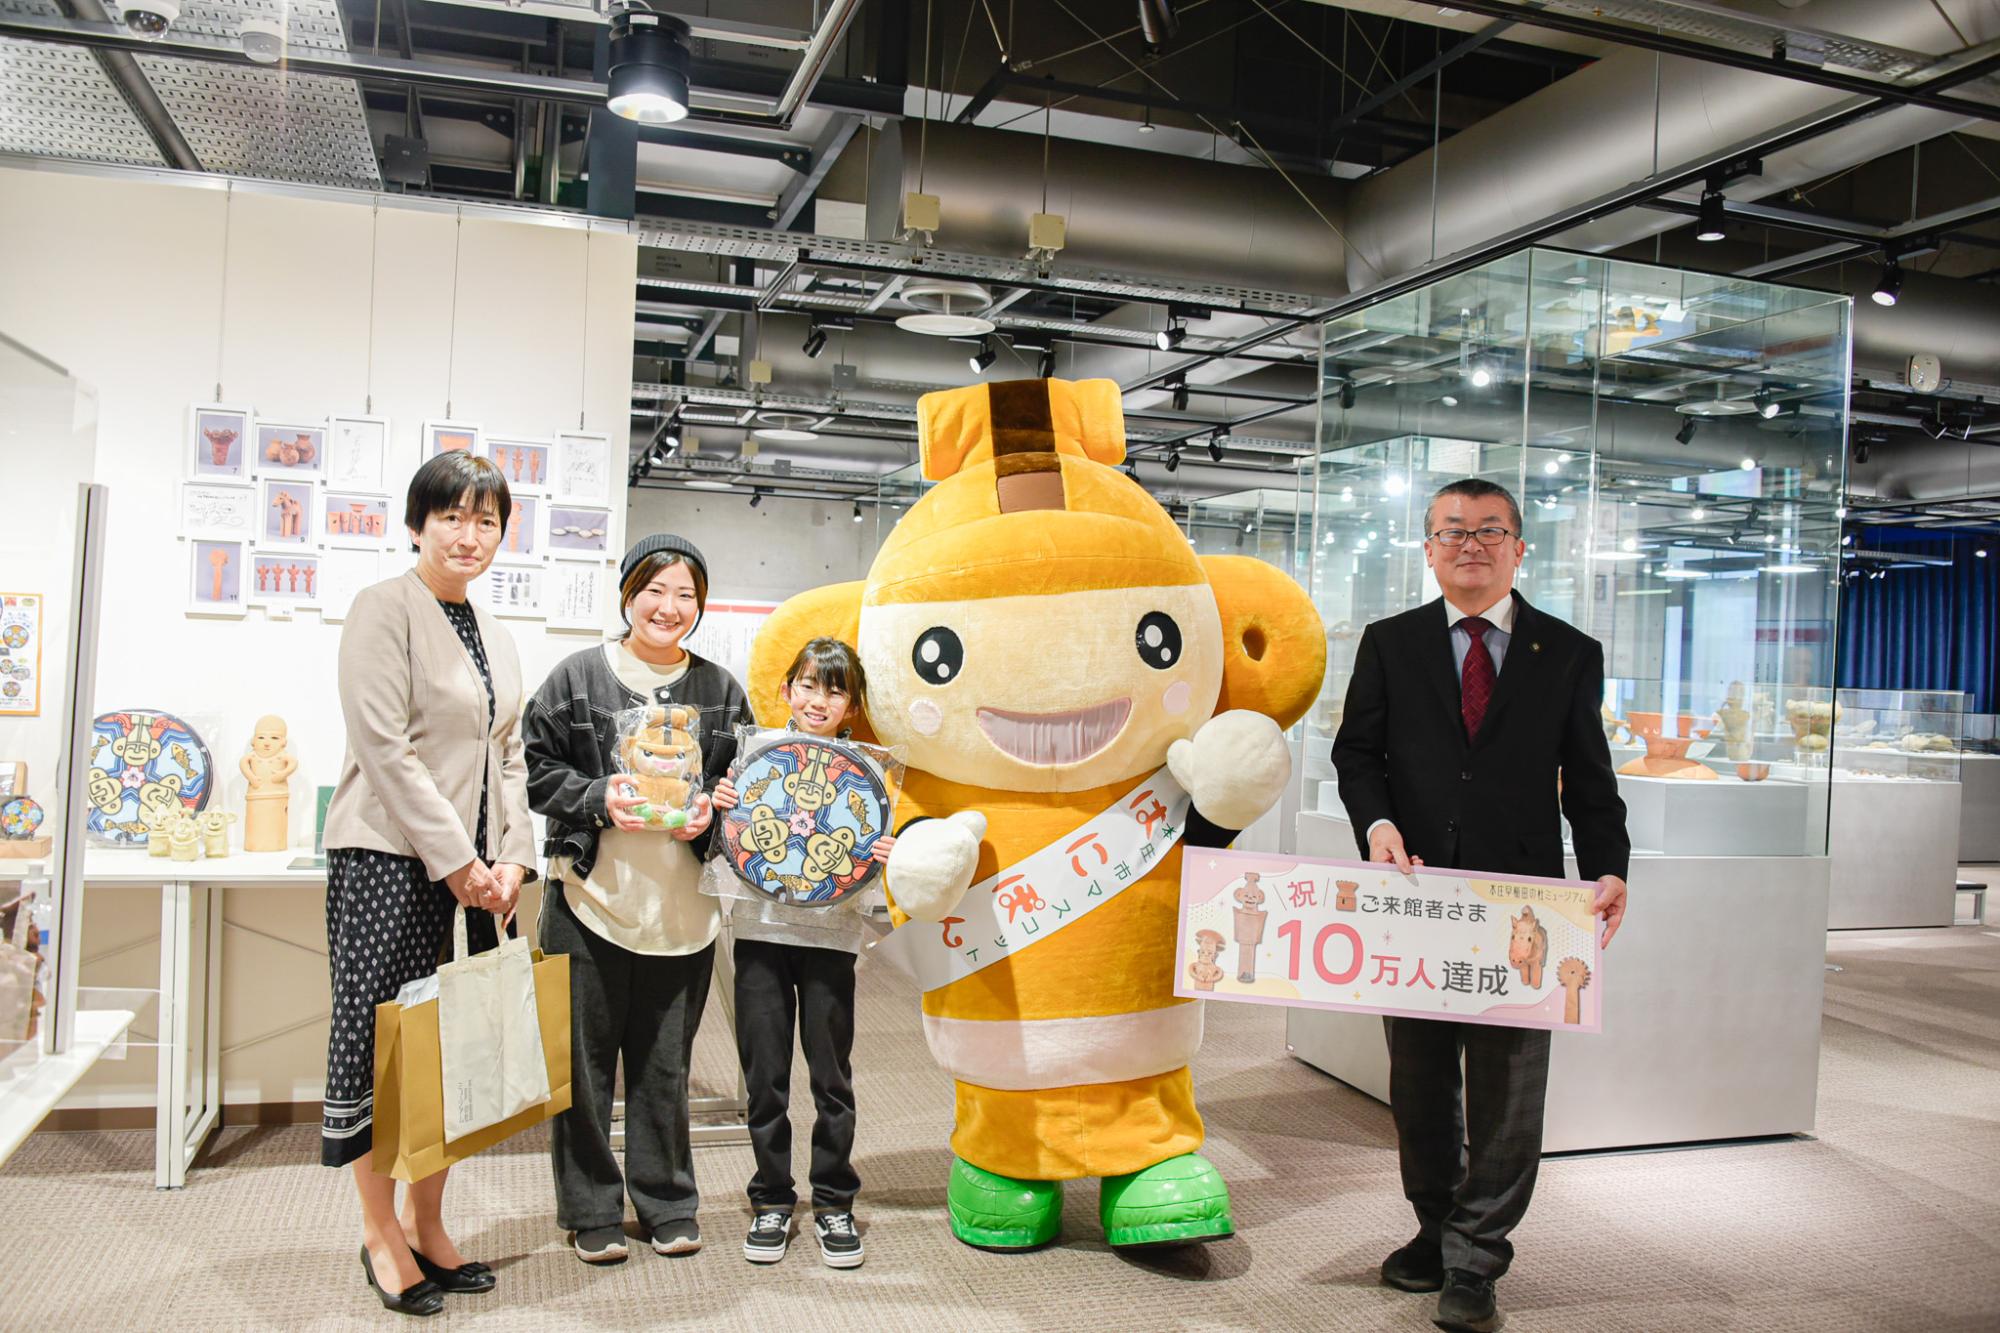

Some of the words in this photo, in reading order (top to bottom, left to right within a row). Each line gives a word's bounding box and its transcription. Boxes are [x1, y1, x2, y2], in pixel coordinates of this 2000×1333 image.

[938, 789, 1168, 948] はにぽん
[966, 823, 1177, 962] 本庄市マスコット
[1287, 879, 1318, 909] 祝
[1360, 893, 1487, 923] ご来館者さま
[1276, 919, 1510, 997] 10万人達成
